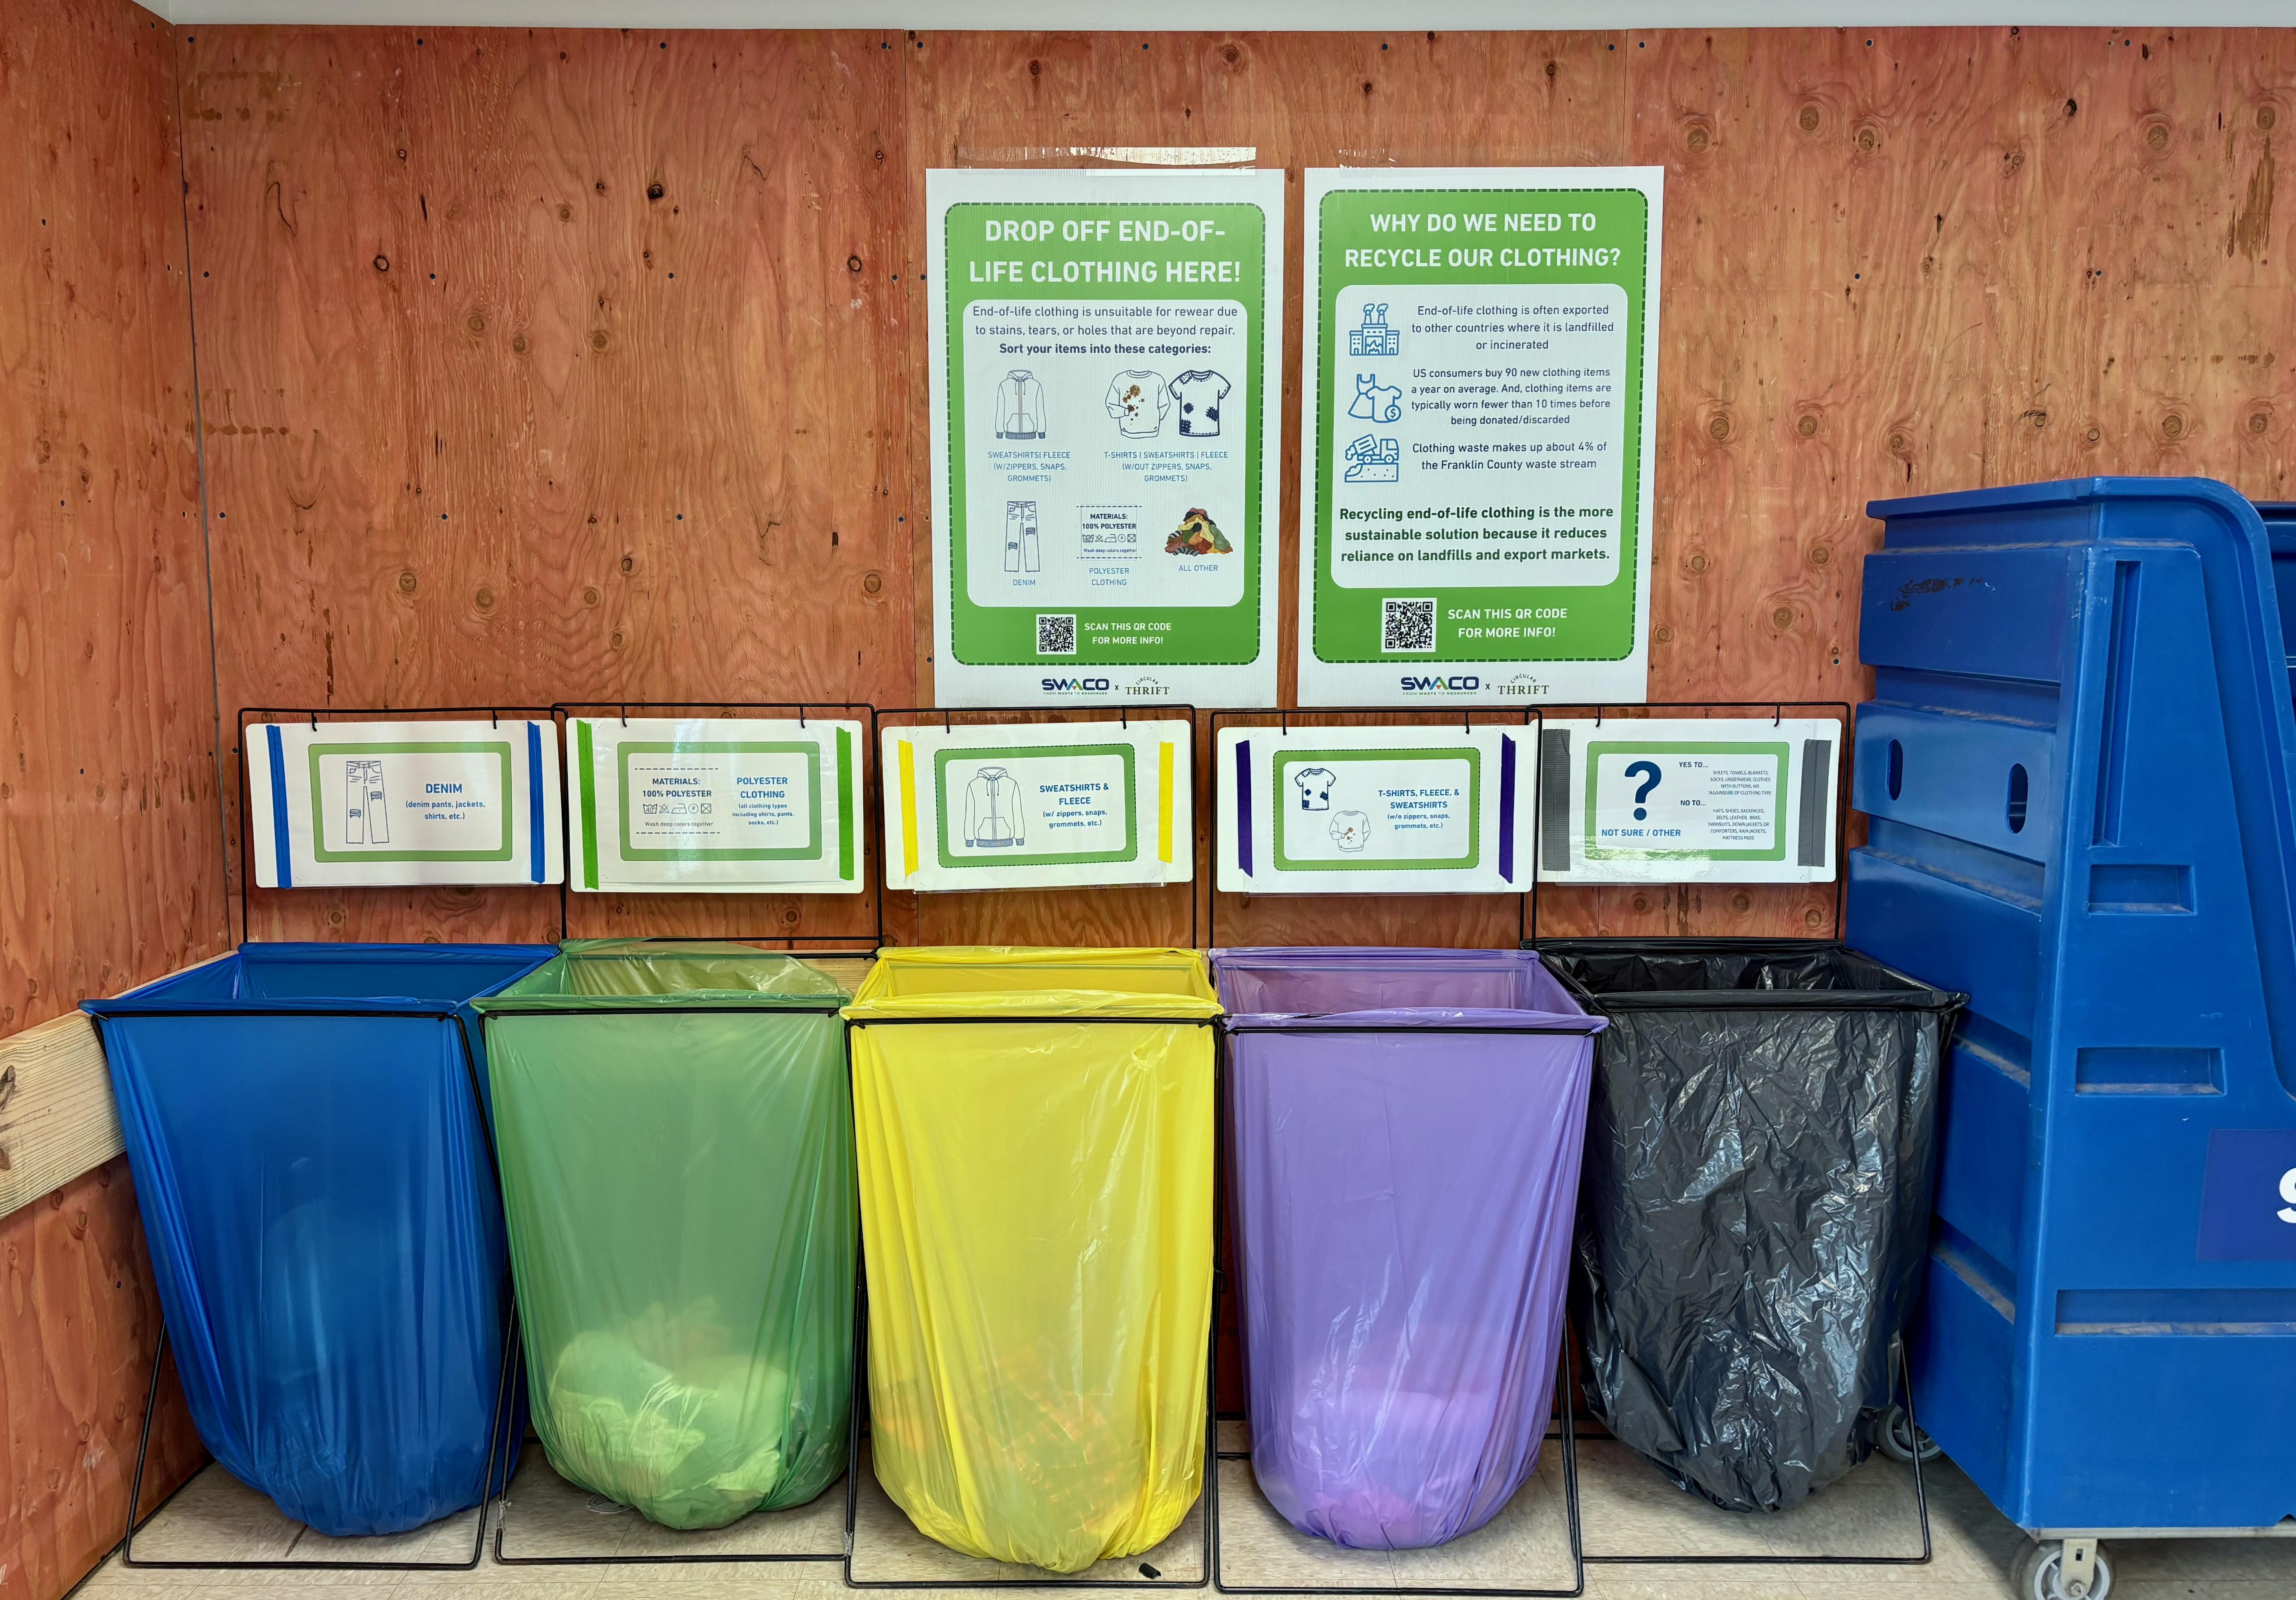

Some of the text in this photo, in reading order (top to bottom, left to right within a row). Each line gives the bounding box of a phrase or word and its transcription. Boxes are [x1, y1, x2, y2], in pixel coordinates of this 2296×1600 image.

[1370, 213, 1596, 231] WHY DO WE NEED TO
[986, 220, 1224, 241] DROP OFF END-OF-
[1346, 248, 1620, 267] RECYCLE OUR CLOTHING?
[970, 261, 1240, 282] LIFE CLOTHING HERE!
[973, 306, 1031, 316] End-of-life
[1035, 306, 1078, 318] clothing
[1082, 306, 1091, 316] is
[1095, 306, 1152, 316] unsuitable
[1156, 306, 1171, 316] for
[1217, 306, 1237, 316] due
[1418, 305, 1608, 317] End-of-life clothing is often exported
[1000, 343, 1210, 355] Sort your items into these categories:
[1413, 369, 1426, 377] US
[1486, 368, 1502, 379] buy
[1505, 368, 1517, 377] 90
[1543, 367, 1580, 378] clothing
[1584, 367, 1610, 376] items
[1411, 400, 1451, 411] typically
[1481, 400, 1508, 408] fewer
[1512, 400, 1532, 408] than
[1536, 399, 1547, 408] 10
[1550, 399, 1576, 408] times
[1580, 399, 1610, 407] before
[1412, 441, 1607, 454] Clothing waste makes up about 4% of
[1422, 459, 1596, 470] the Franklin County waste stream
[1340, 506, 1613, 522] Recycling end-of-life clothing is the more
[1345, 527, 1606, 540] sustainable solution because it reduces
[1341, 550, 1393, 561] reliance
[1418, 549, 1472, 560] landfills
[1476, 548, 1499, 560] and
[1504, 549, 1547, 562] export
[1551, 548, 1609, 559] markets.
[1136, 676, 1158, 685] CIRCULAR
[1400, 677, 1479, 690] SWACO
[1510, 673, 1536, 683] CIRCULAR
[1042, 679, 1109, 691] SWACO
[1497, 685, 1549, 694] THRIFT
[426, 783, 462, 793] DENIM
[1040, 783, 1100, 792] SWEATSHIRTS
[1059, 796, 1091, 805] FLEECE
